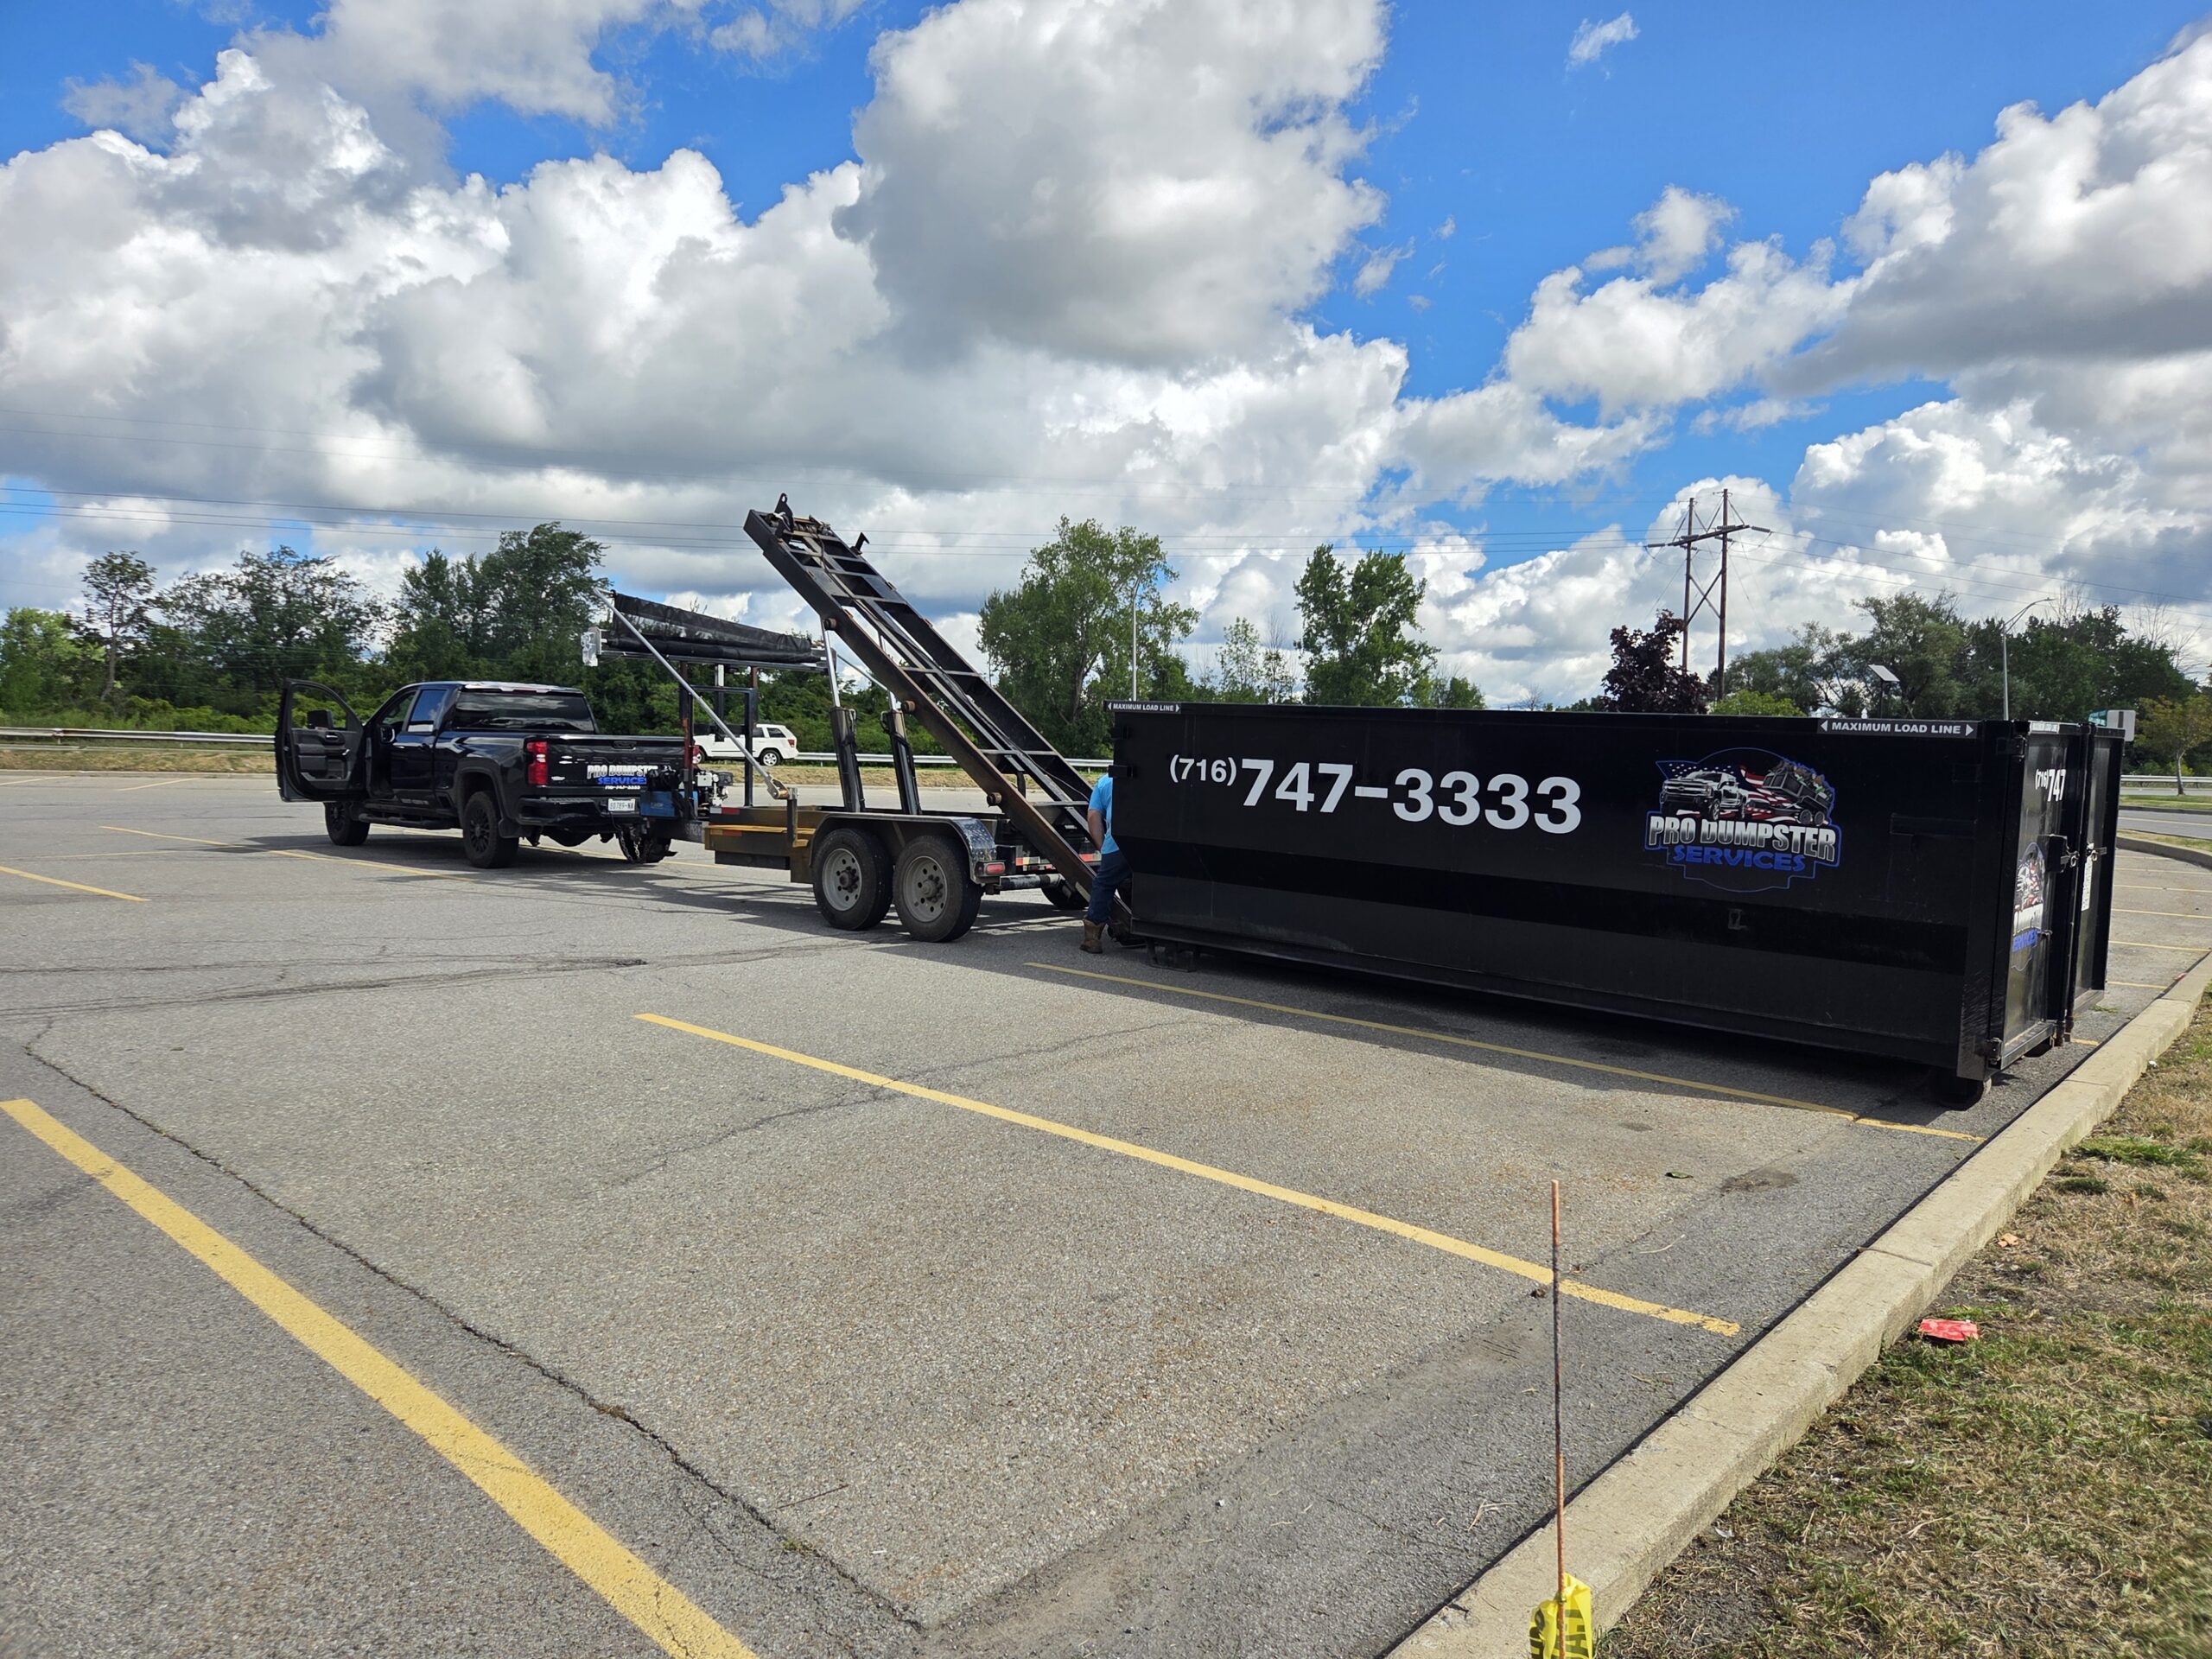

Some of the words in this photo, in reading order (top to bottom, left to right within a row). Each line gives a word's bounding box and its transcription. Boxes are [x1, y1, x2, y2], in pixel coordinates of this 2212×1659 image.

[1832, 721, 1891, 732] MAXIMUM
[1894, 723, 1928, 734] LOAD
[1931, 724, 1961, 734] LINE
[588, 765, 607, 779] PRO
[609, 765, 658, 777] DUMPST
[1170, 754, 1236, 786] (716)
[1241, 759, 1582, 835] 747-3333
[1649, 816, 1696, 846] PRO
[1700, 819, 1837, 862] DUMPSTER
[1673, 845, 1806, 872] SERVICES
